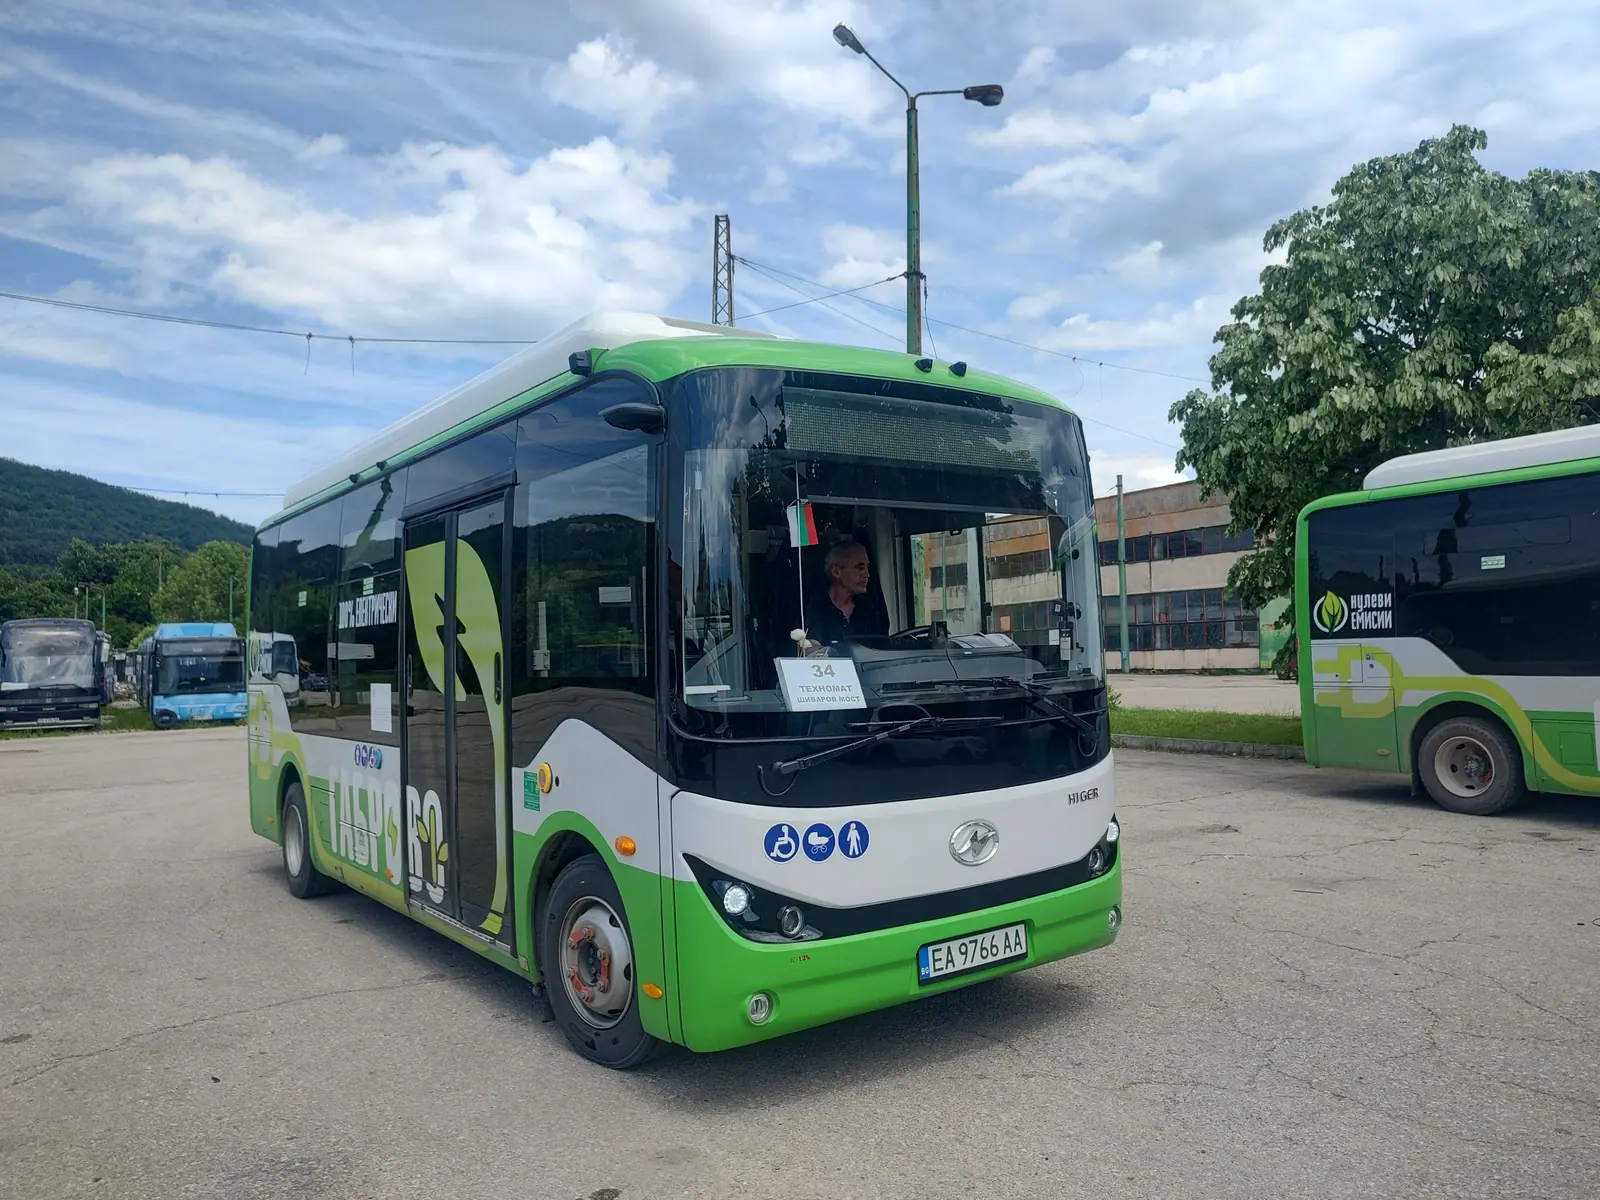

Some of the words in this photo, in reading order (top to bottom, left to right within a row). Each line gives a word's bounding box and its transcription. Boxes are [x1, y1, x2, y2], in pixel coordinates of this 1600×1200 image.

[1351, 610, 1393, 630] ЕМИСИИ
[811, 664, 835, 678] 34
[799, 685, 852, 693] ТЕХНОМАТ
[1067, 787, 1099, 806] HIGER
[931, 945, 956, 973] EA
[958, 934, 999, 966] 9766
[1003, 928, 1023, 955] AA
